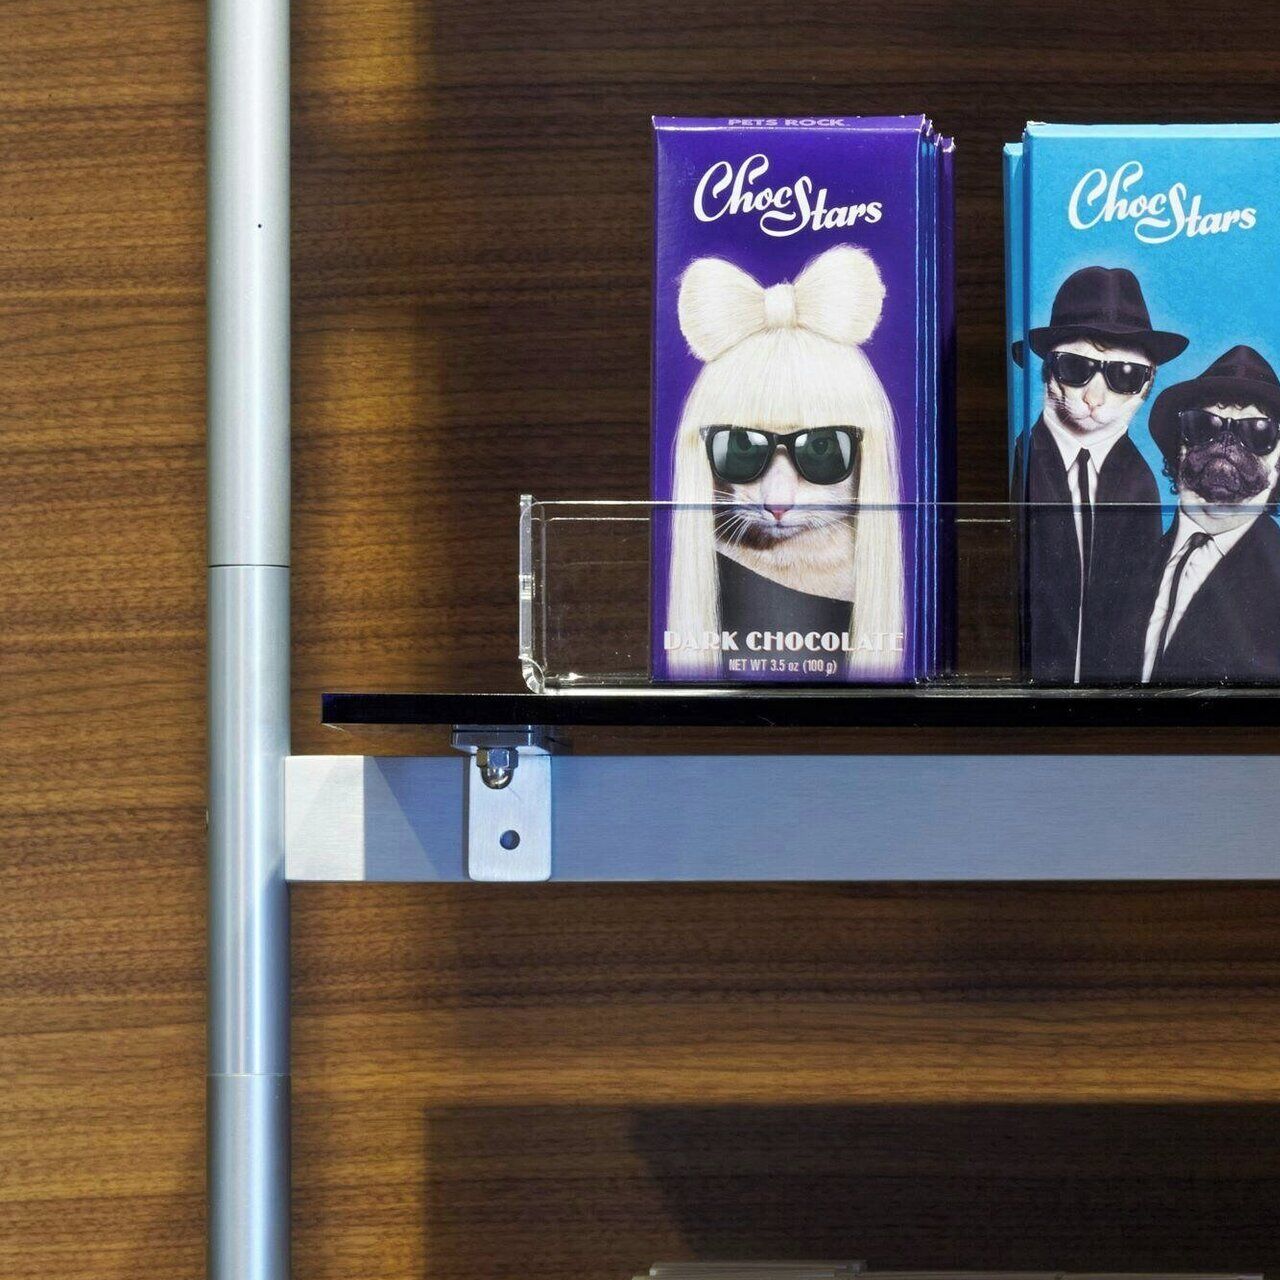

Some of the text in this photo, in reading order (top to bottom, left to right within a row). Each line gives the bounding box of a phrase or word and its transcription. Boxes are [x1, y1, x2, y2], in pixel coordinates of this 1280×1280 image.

[728, 118, 845, 127] PETS ROCK
[663, 631, 904, 652] DARK CHOCOLATE
[729, 659, 838, 677] NET WT 3.5 oz (100 g)
